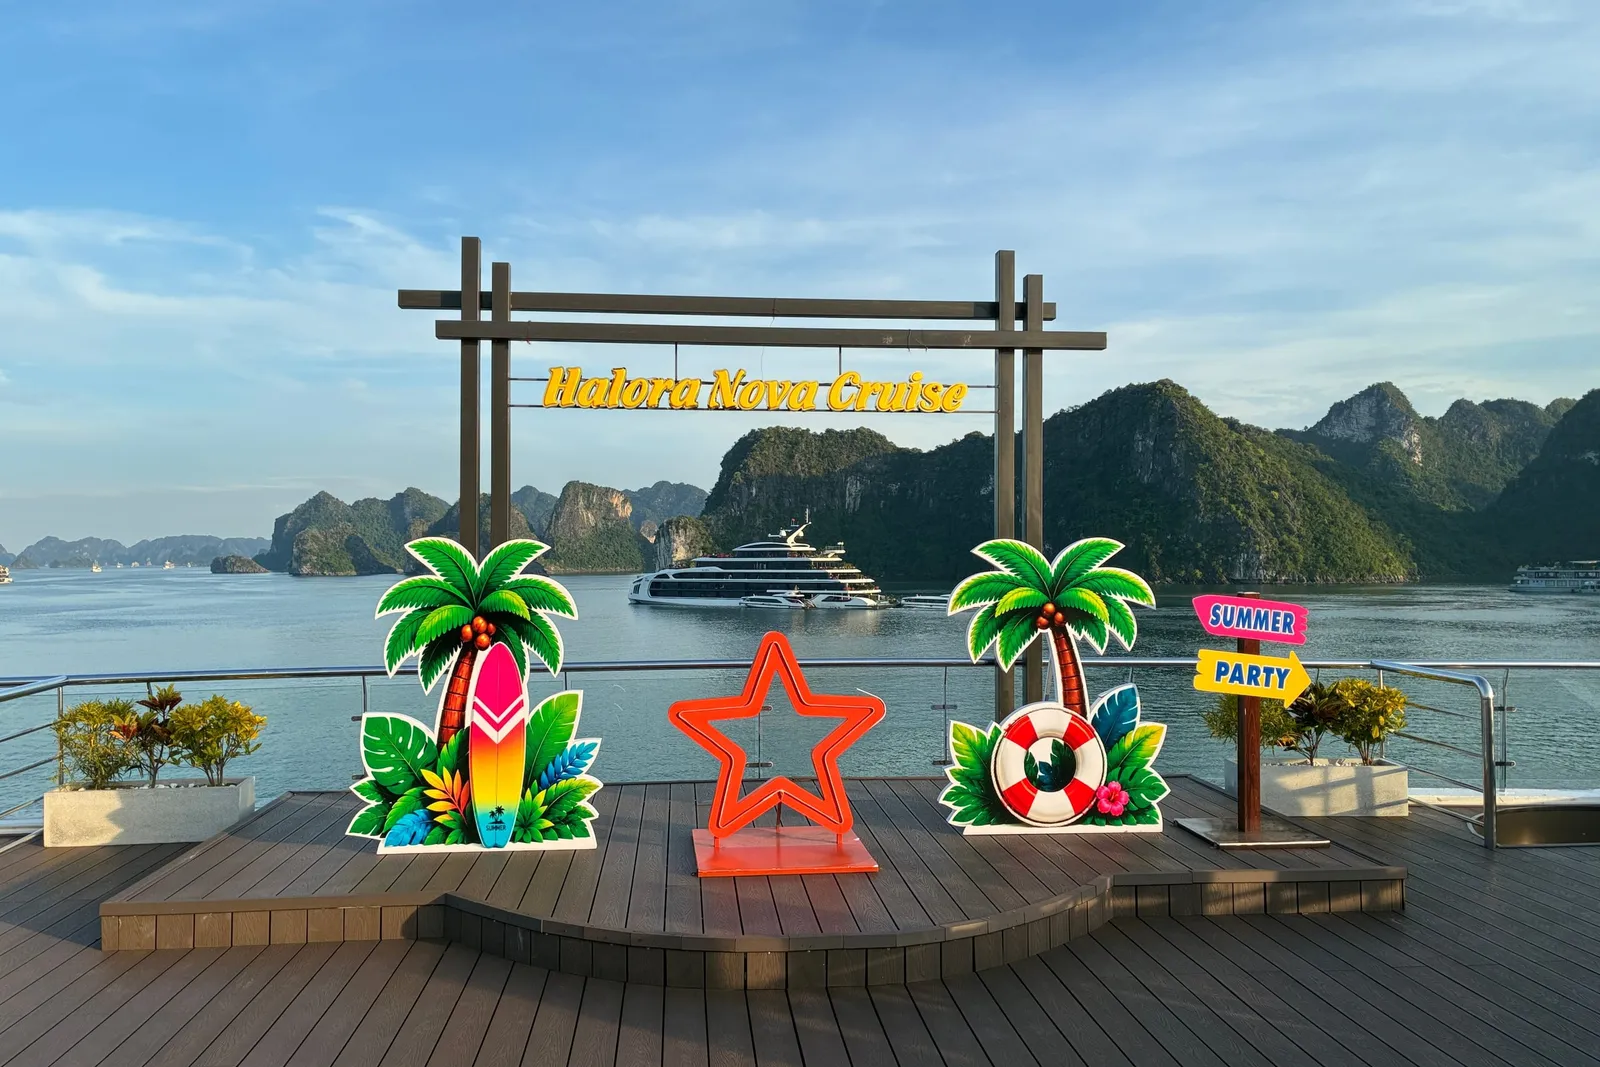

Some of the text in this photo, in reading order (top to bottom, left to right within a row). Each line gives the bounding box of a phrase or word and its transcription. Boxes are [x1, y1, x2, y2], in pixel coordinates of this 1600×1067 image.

[542, 366, 968, 413] Halora Nova Cruise
[1209, 603, 1295, 635] SUMMER
[1215, 661, 1290, 690] PARTY
